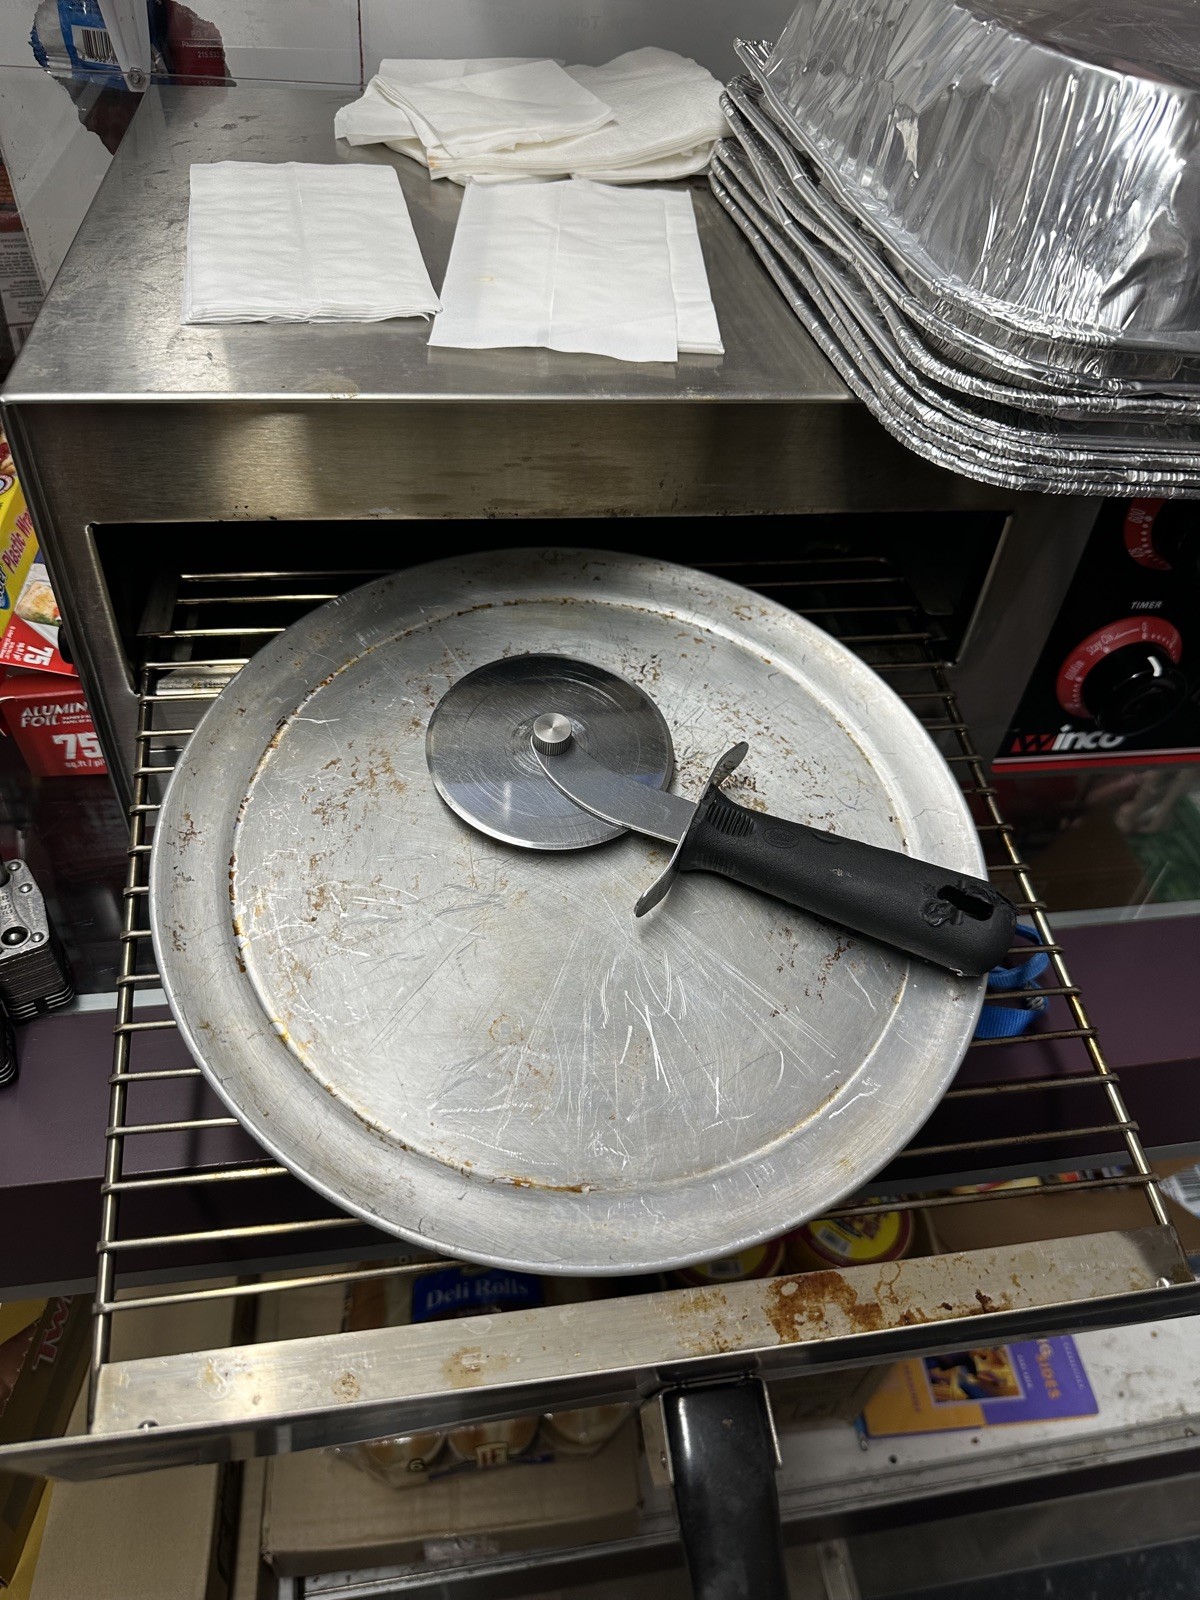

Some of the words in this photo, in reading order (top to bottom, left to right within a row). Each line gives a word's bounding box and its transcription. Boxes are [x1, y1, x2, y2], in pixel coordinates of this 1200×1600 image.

[2, 532, 26, 575] Plastic
[15, 509, 33, 538] Wra
[1130, 600, 1163, 610] TIMER
[27, 645, 55, 666] 75
[1086, 641, 1103, 656] Stay
[1101, 634, 1114, 645] On
[21, 701, 88, 717] ALUMIN
[21, 715, 58, 728] FOIL
[52, 732, 104, 759] 75
[426, 1282, 470, 1310] Deli
[474, 1278, 529, 1296] Rolls
